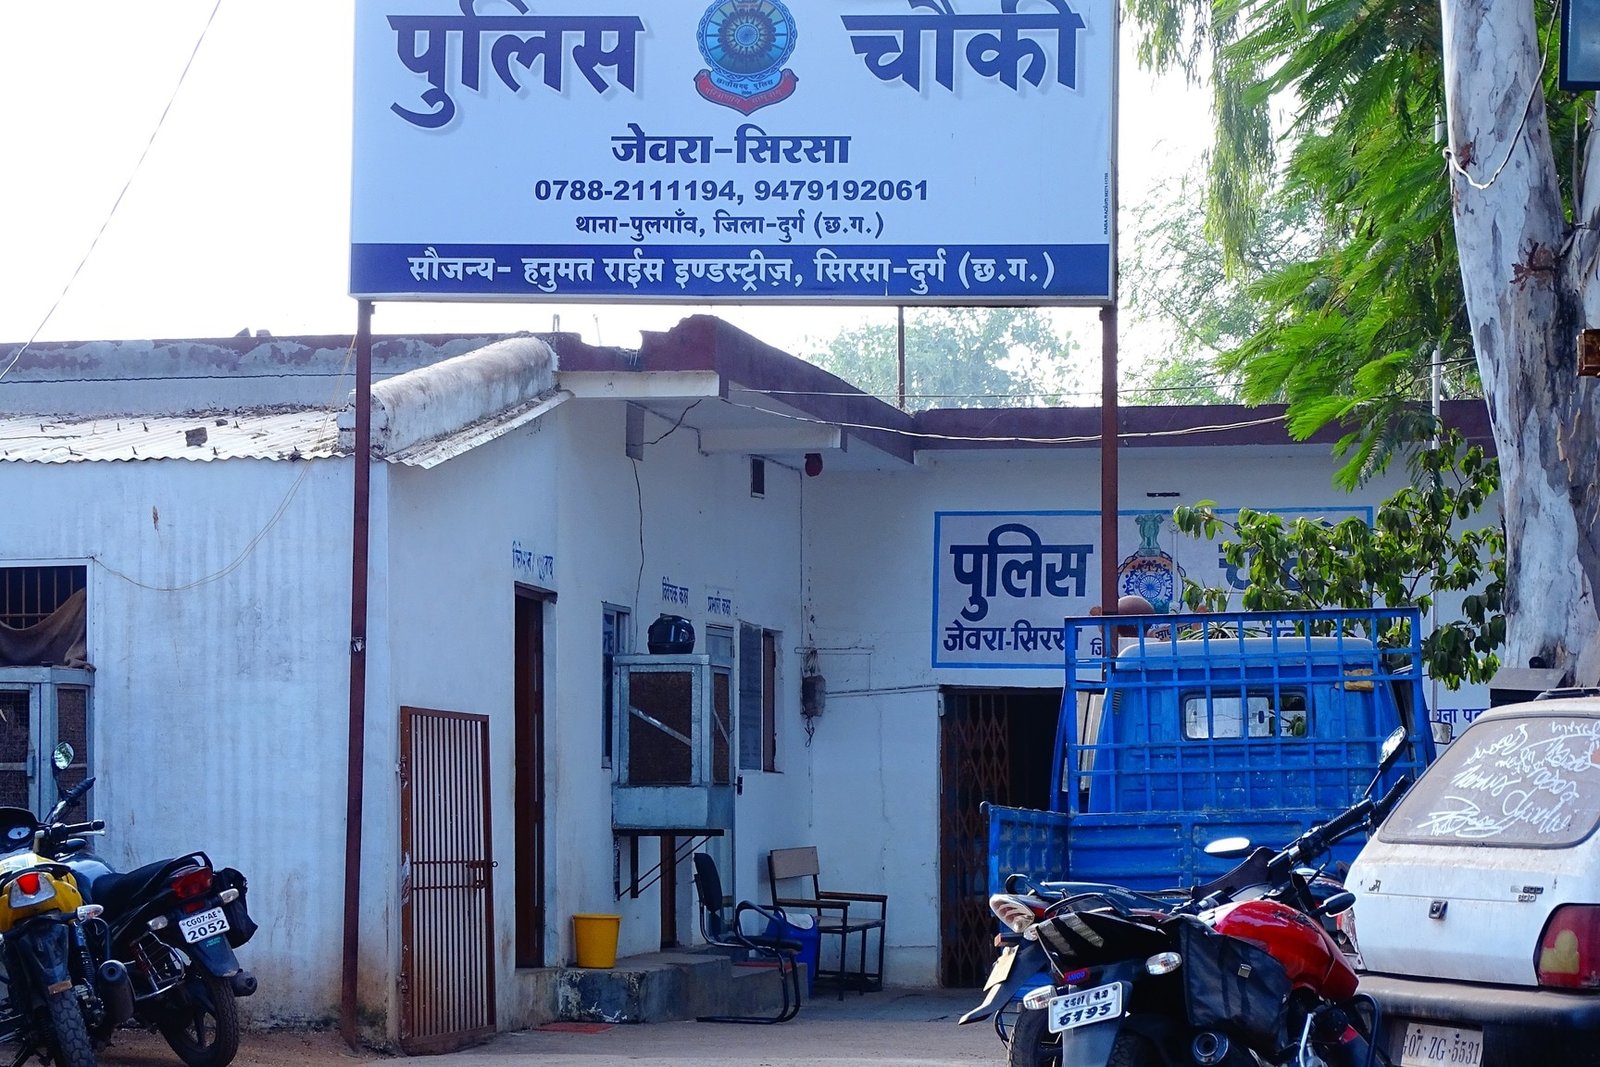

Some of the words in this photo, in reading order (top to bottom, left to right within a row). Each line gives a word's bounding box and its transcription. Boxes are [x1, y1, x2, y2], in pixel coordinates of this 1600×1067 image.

[387, 0, 645, 129] पुलिस
[611, 123, 851, 164] जेवरा-सिरसा
[535, 180, 744, 206] 0788-2111194,
[754, 180, 928, 201] 9479192061
[713, 209, 806, 243] जिला-दुर्ग
[814, 211, 884, 239] (छ.ग.)
[521, 258, 594, 292] हनुमत
[602, 248, 664, 288] राईस
[813, 248, 947, 293] सिरसा-दुर्ग
[958, 252, 1055, 290] (छ.ग.)
[950, 523, 1093, 622] पुलिस
[187, 919, 227, 941] 2052
